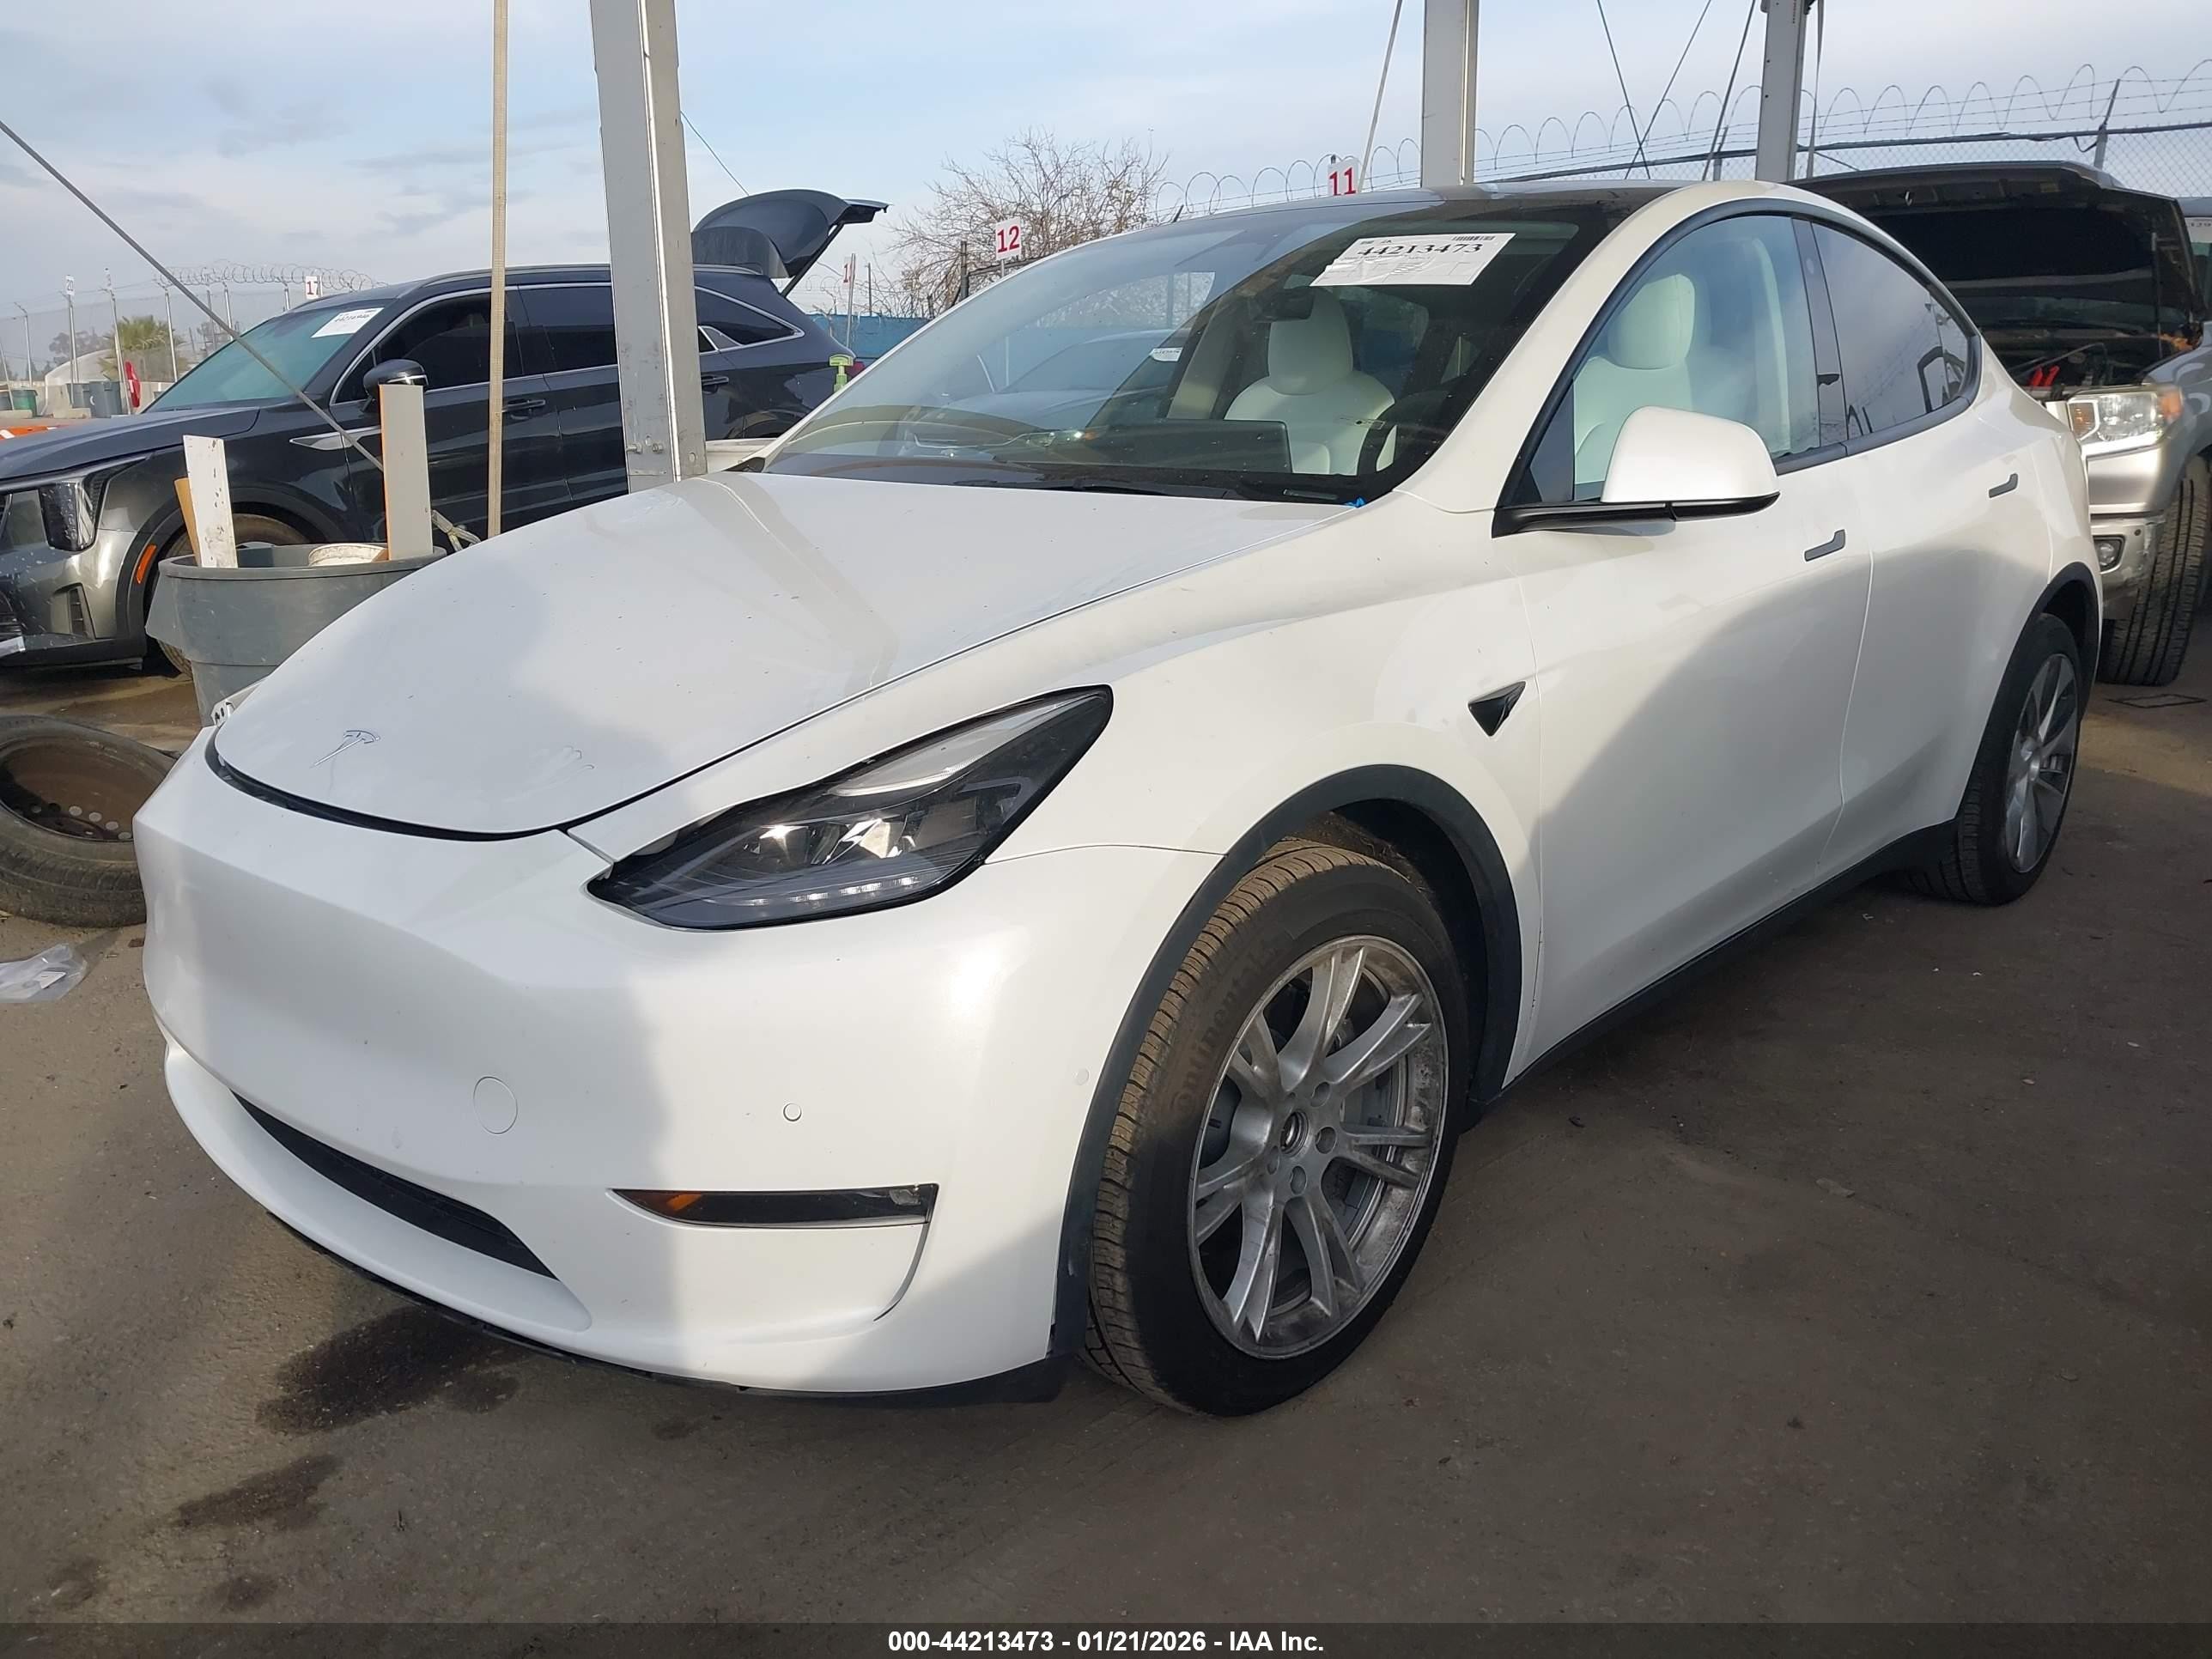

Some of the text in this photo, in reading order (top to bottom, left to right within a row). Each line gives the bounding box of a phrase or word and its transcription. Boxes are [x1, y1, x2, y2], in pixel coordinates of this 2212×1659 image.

[1329, 167, 1357, 196] 11
[997, 225, 1020, 252] 12
[1357, 243, 1484, 256] 44213473
